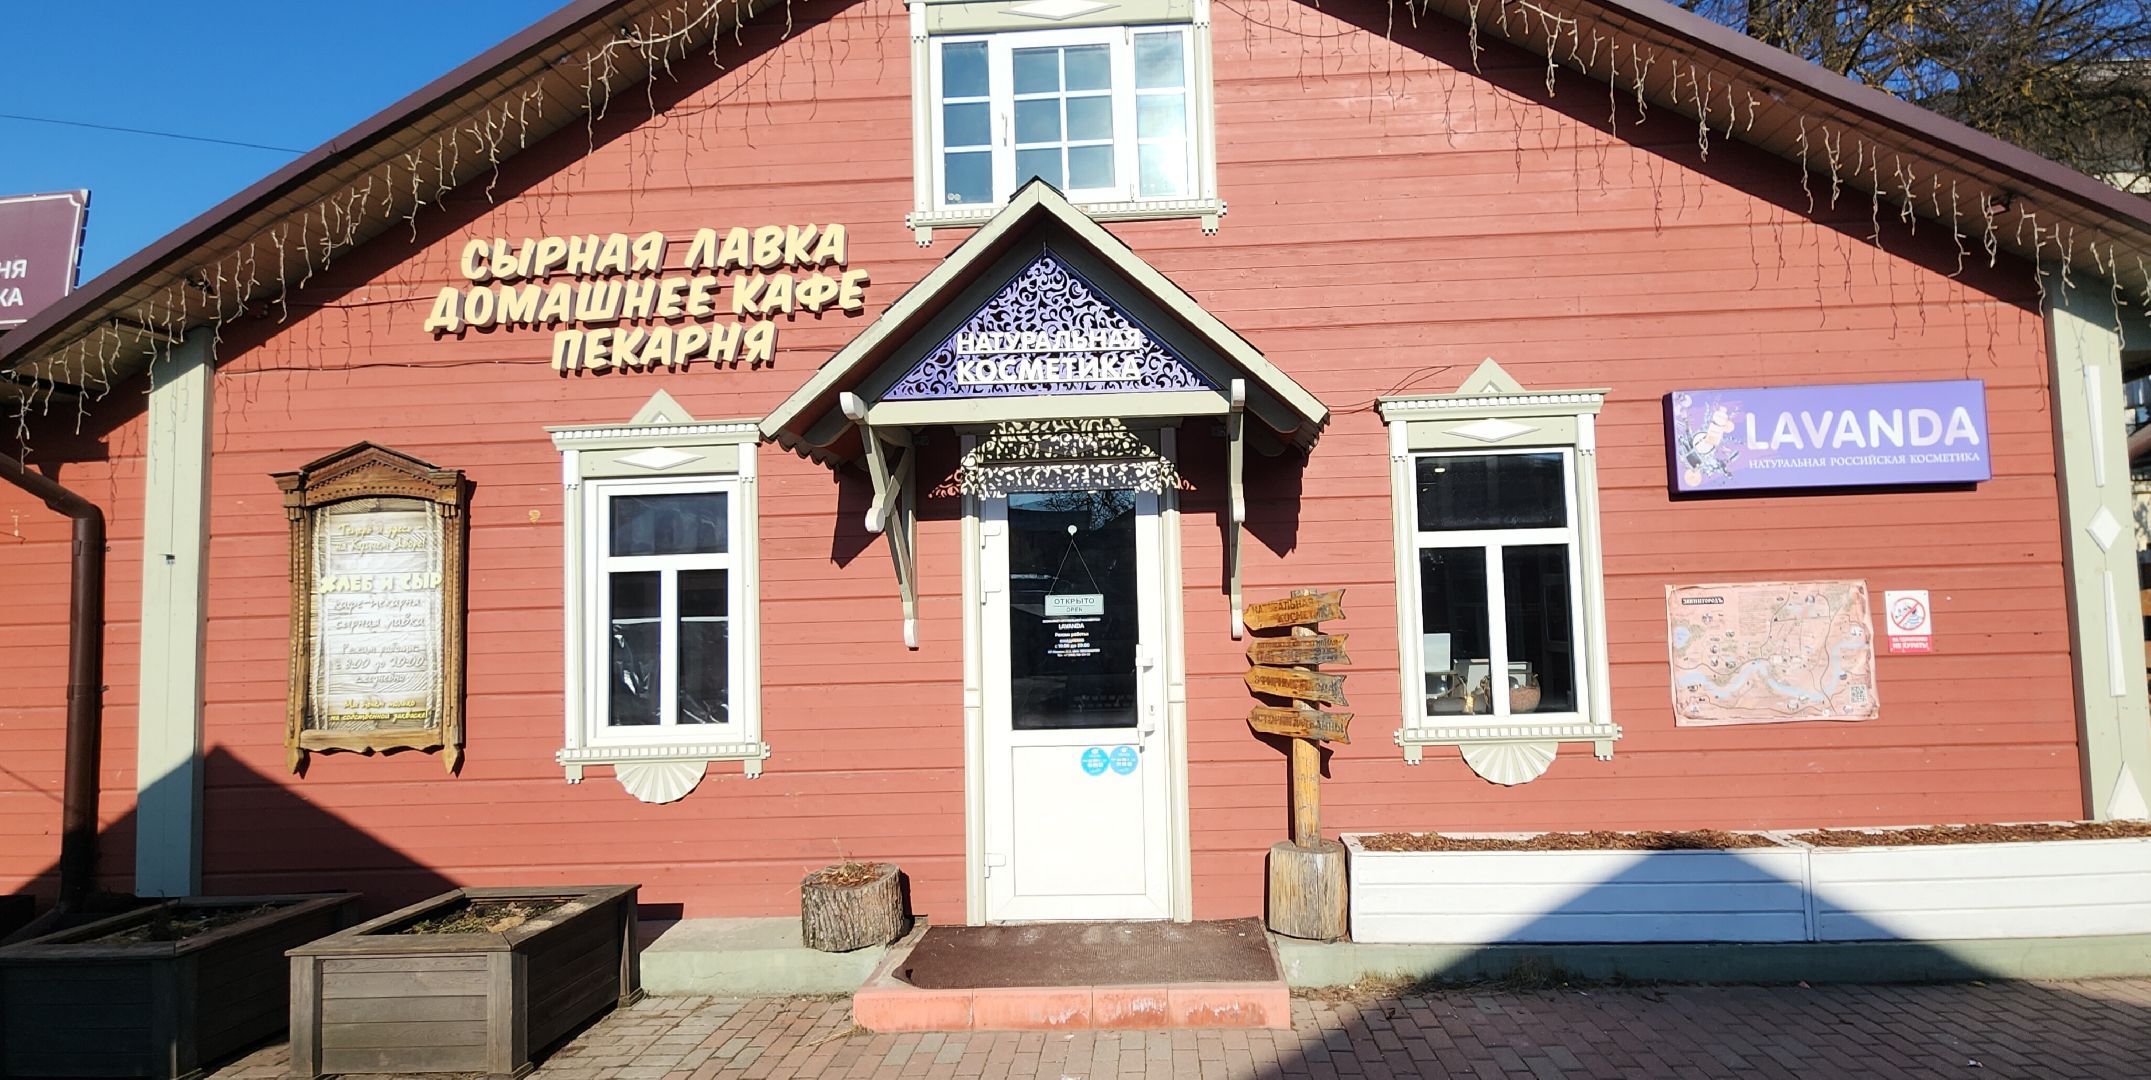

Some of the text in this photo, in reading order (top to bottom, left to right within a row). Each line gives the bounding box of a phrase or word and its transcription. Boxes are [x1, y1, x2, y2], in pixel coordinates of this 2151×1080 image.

[461, 224, 848, 281] СЫРНАЯ ЛАВКА
[424, 269, 870, 335] ДОМАШНЕЕ КАФЕ
[551, 320, 778, 372] ПЕКАРНЯ
[956, 329, 1141, 353] НАТУРАЛЬНАЯ
[956, 355, 1141, 383] КОСМЕТИКА
[1746, 406, 1980, 451] LAVANDA
[1749, 452, 1980, 470] НАТУРАЛЬНАЯ РОССИЙСКАЯ КОСМЕТИКА
[383, 576, 394, 592] И
[402, 572, 442, 590] СЫР
[337, 613, 426, 633] сырная лавка
